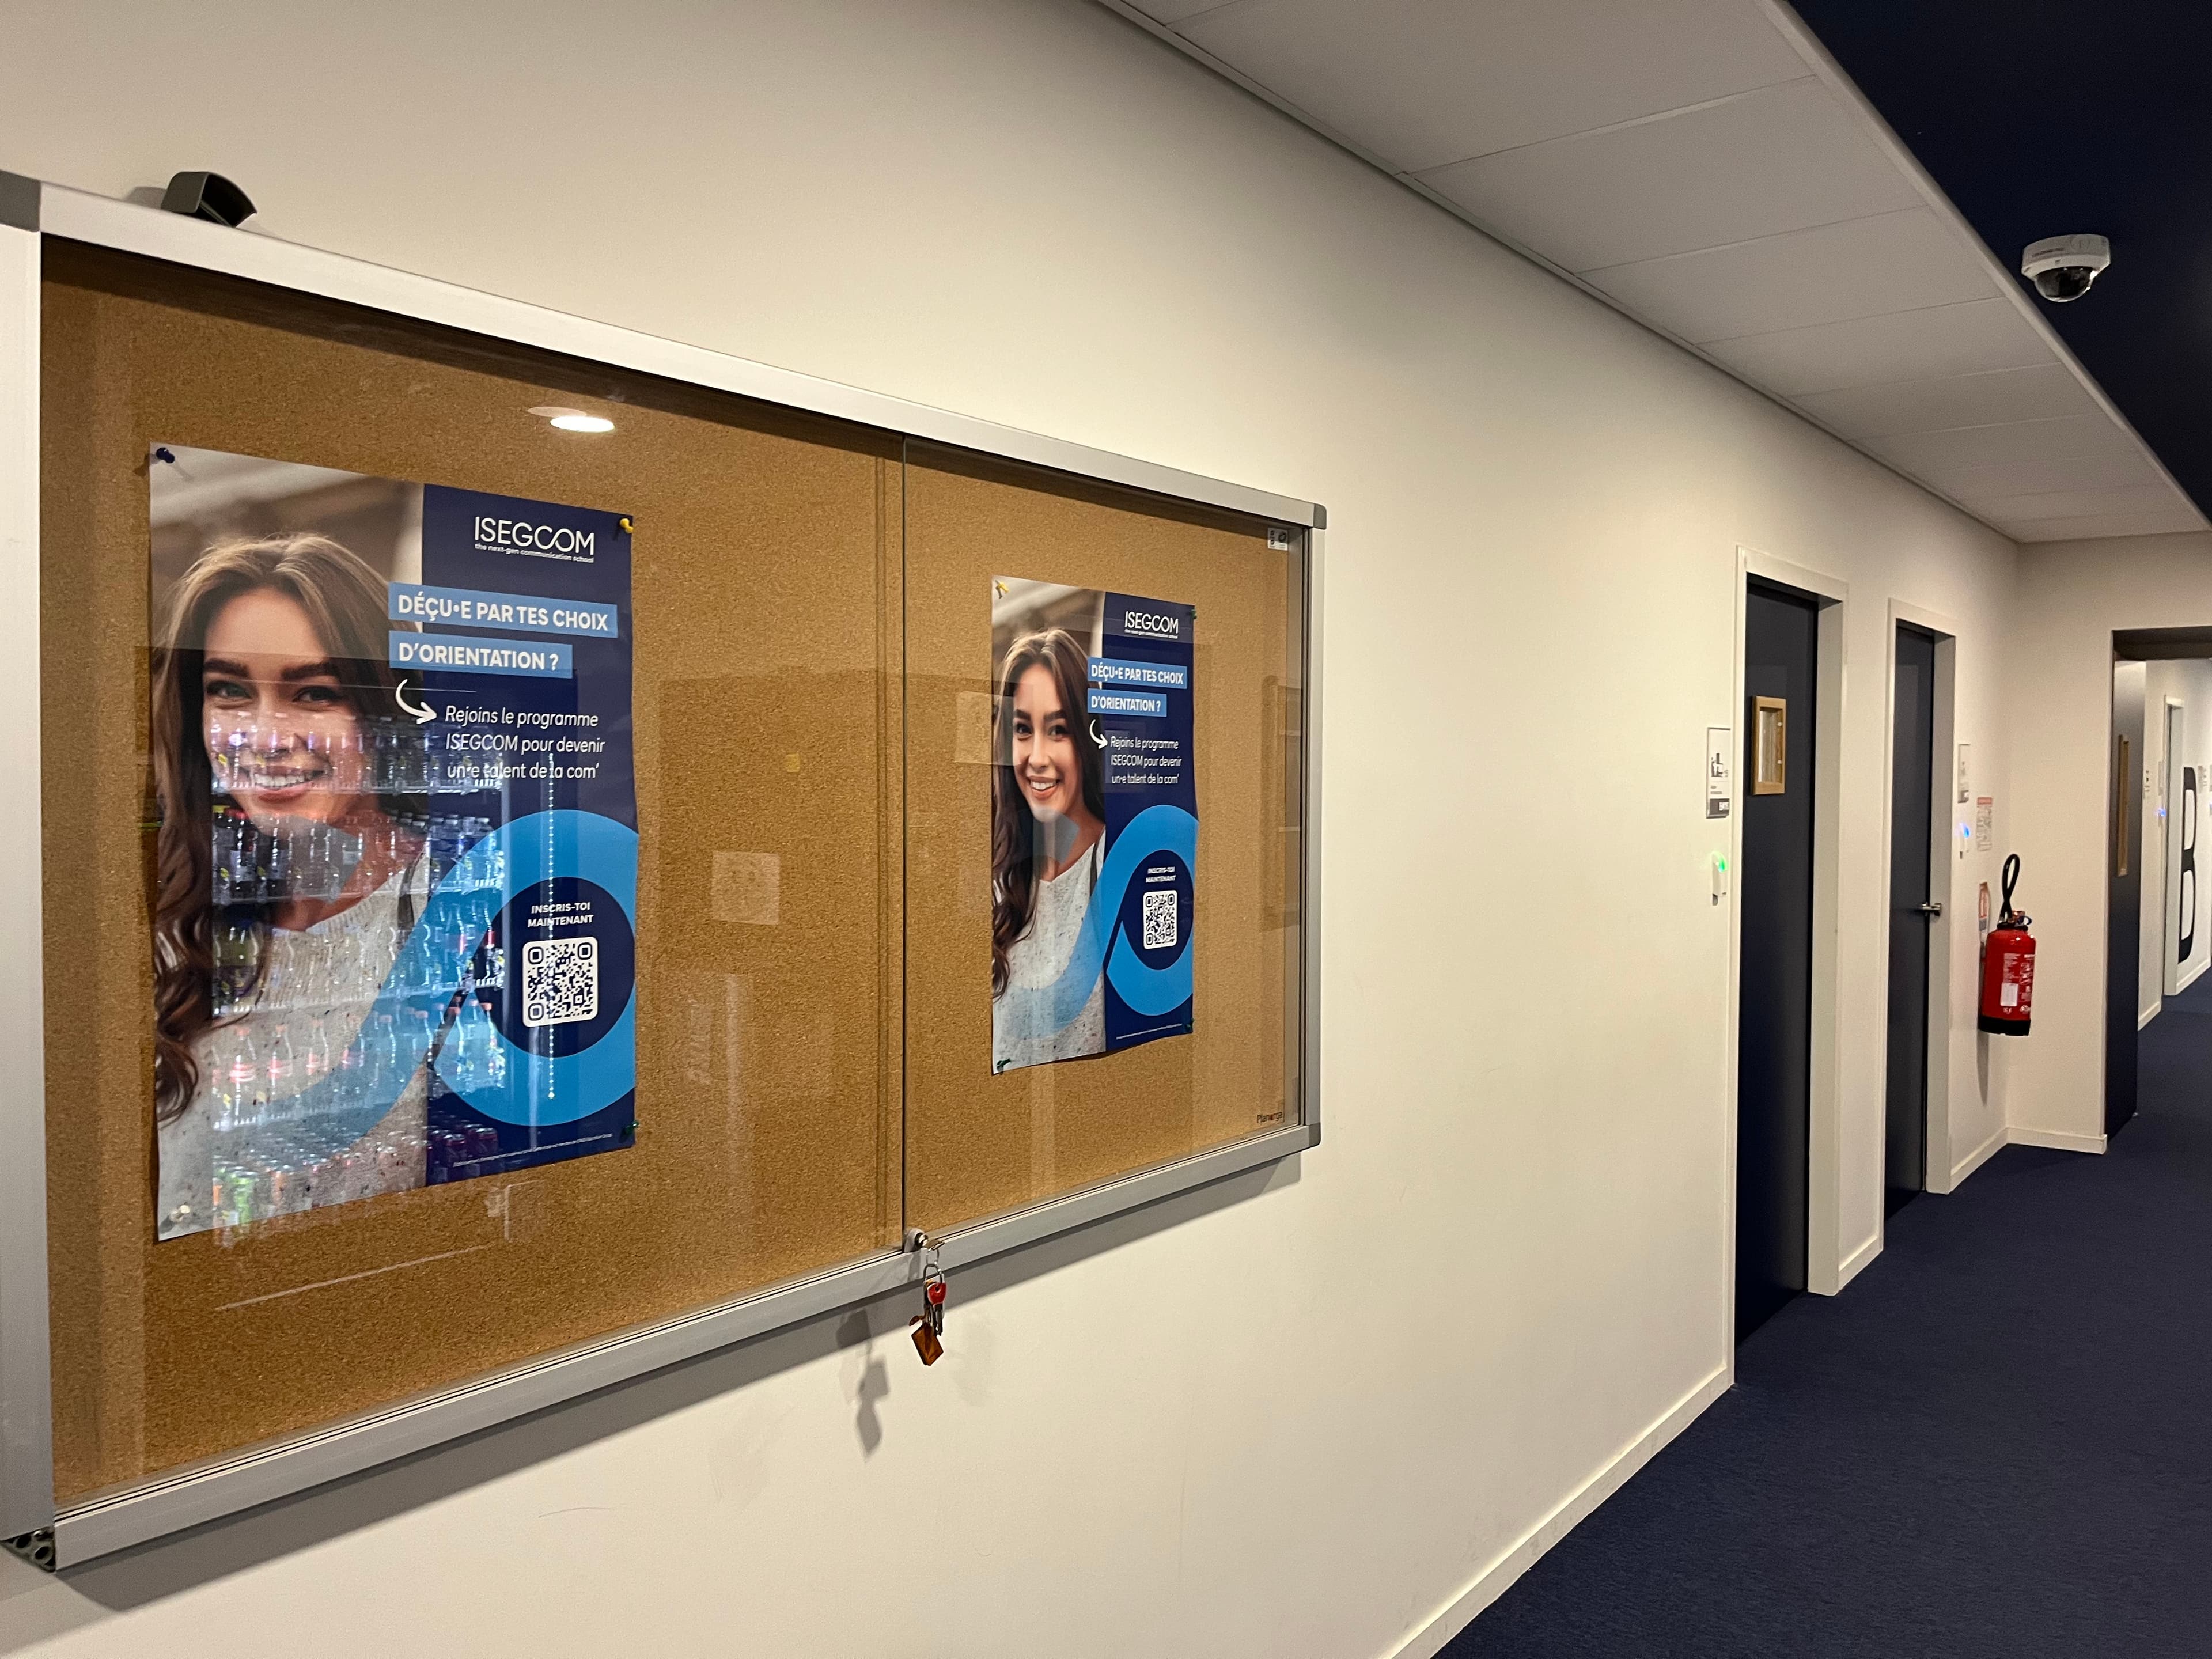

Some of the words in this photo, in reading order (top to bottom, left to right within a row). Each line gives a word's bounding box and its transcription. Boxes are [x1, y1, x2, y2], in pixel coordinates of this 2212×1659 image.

[475, 516, 594, 555] ISEGCOM
[476, 603, 513, 622] PAR
[516, 606, 548, 626] TES
[552, 609, 608, 631] CHOIX
[1124, 611, 1179, 634] ISEGCOM
[399, 643, 545, 670] D'ORIENTATION
[549, 653, 559, 671] ?
[1124, 668, 1141, 680] PAR
[1142, 670, 1156, 683] TES
[1158, 672, 1184, 684] CHOIX
[1091, 695, 1155, 711] D'ORIENTATION
[1156, 700, 1161, 712] ?
[445, 705, 498, 726] Rejoins
[501, 707, 514, 724] le
[517, 712, 599, 729] programme
[446, 733, 518, 751] ISEGCOM
[521, 740, 554, 755] pour
[556, 736, 605, 752] devenir
[1110, 736, 1134, 750] Rejoins
[1135, 737, 1141, 748] le
[1141, 740, 1179, 751] programme
[529, 762, 547, 778] de
[549, 760, 563, 778] la
[566, 762, 599, 778] com'
[1111, 754, 1143, 766] ISEGCOM
[1143, 758, 1159, 768] pour
[1159, 756, 1182, 766] devenir
[1147, 773, 1156, 784] de
[531, 902, 590, 914] INSCRIS-TOI
[527, 914, 594, 927] MAINTENANT
